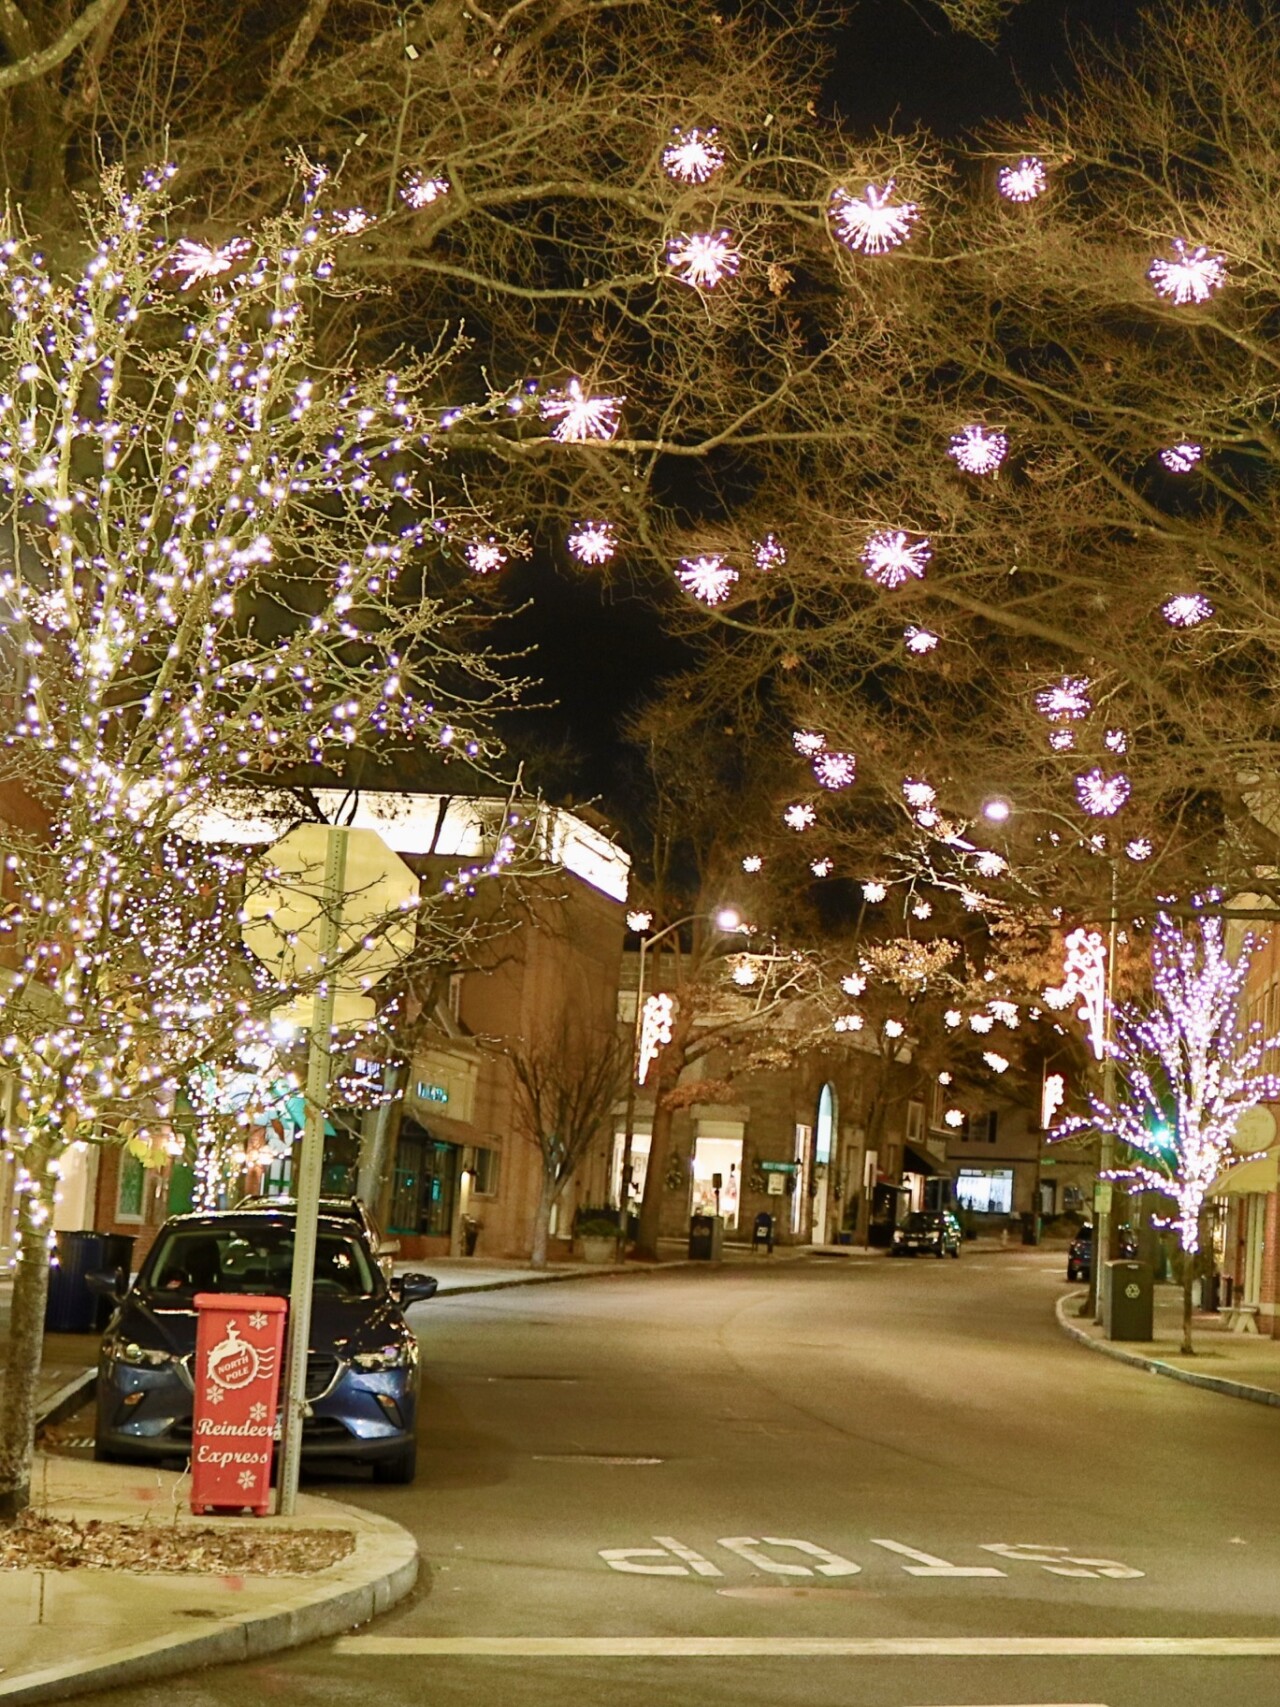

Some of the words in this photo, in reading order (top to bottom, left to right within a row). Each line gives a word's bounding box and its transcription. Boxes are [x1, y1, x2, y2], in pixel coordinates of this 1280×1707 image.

[218, 1355, 250, 1375] NORTH
[225, 1367, 250, 1383] POLE
[196, 1418, 274, 1437] Reindeer
[197, 1445, 269, 1468] Express
[598, 1536, 1146, 1579] STOP
